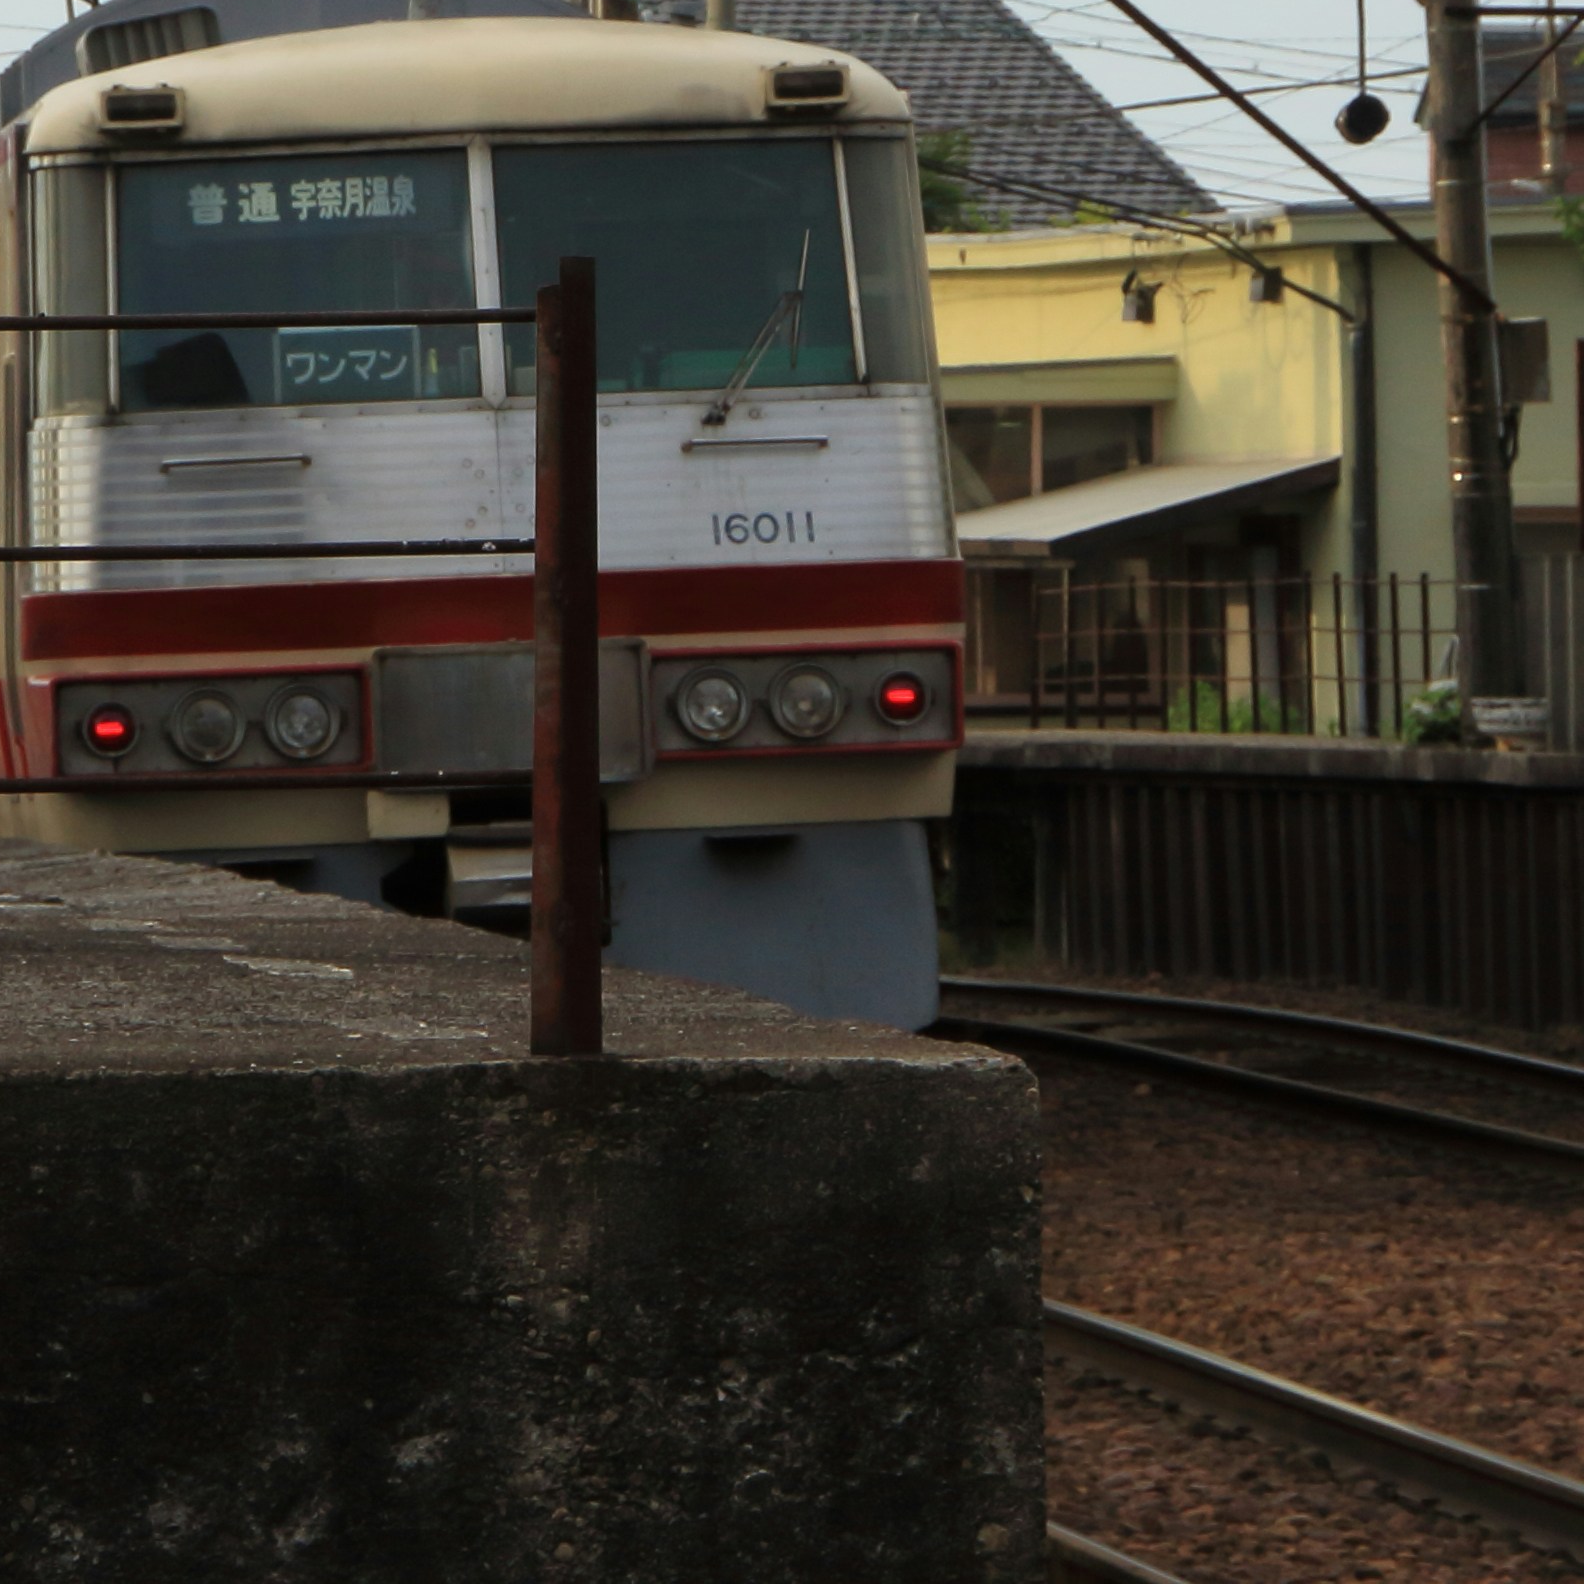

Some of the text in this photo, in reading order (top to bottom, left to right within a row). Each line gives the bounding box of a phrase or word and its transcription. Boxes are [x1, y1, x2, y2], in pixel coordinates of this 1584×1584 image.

[187, 174, 417, 225] 普通 宇奈月温泉
[286, 349, 408, 384] ワンマン
[711, 510, 815, 546] 16011
